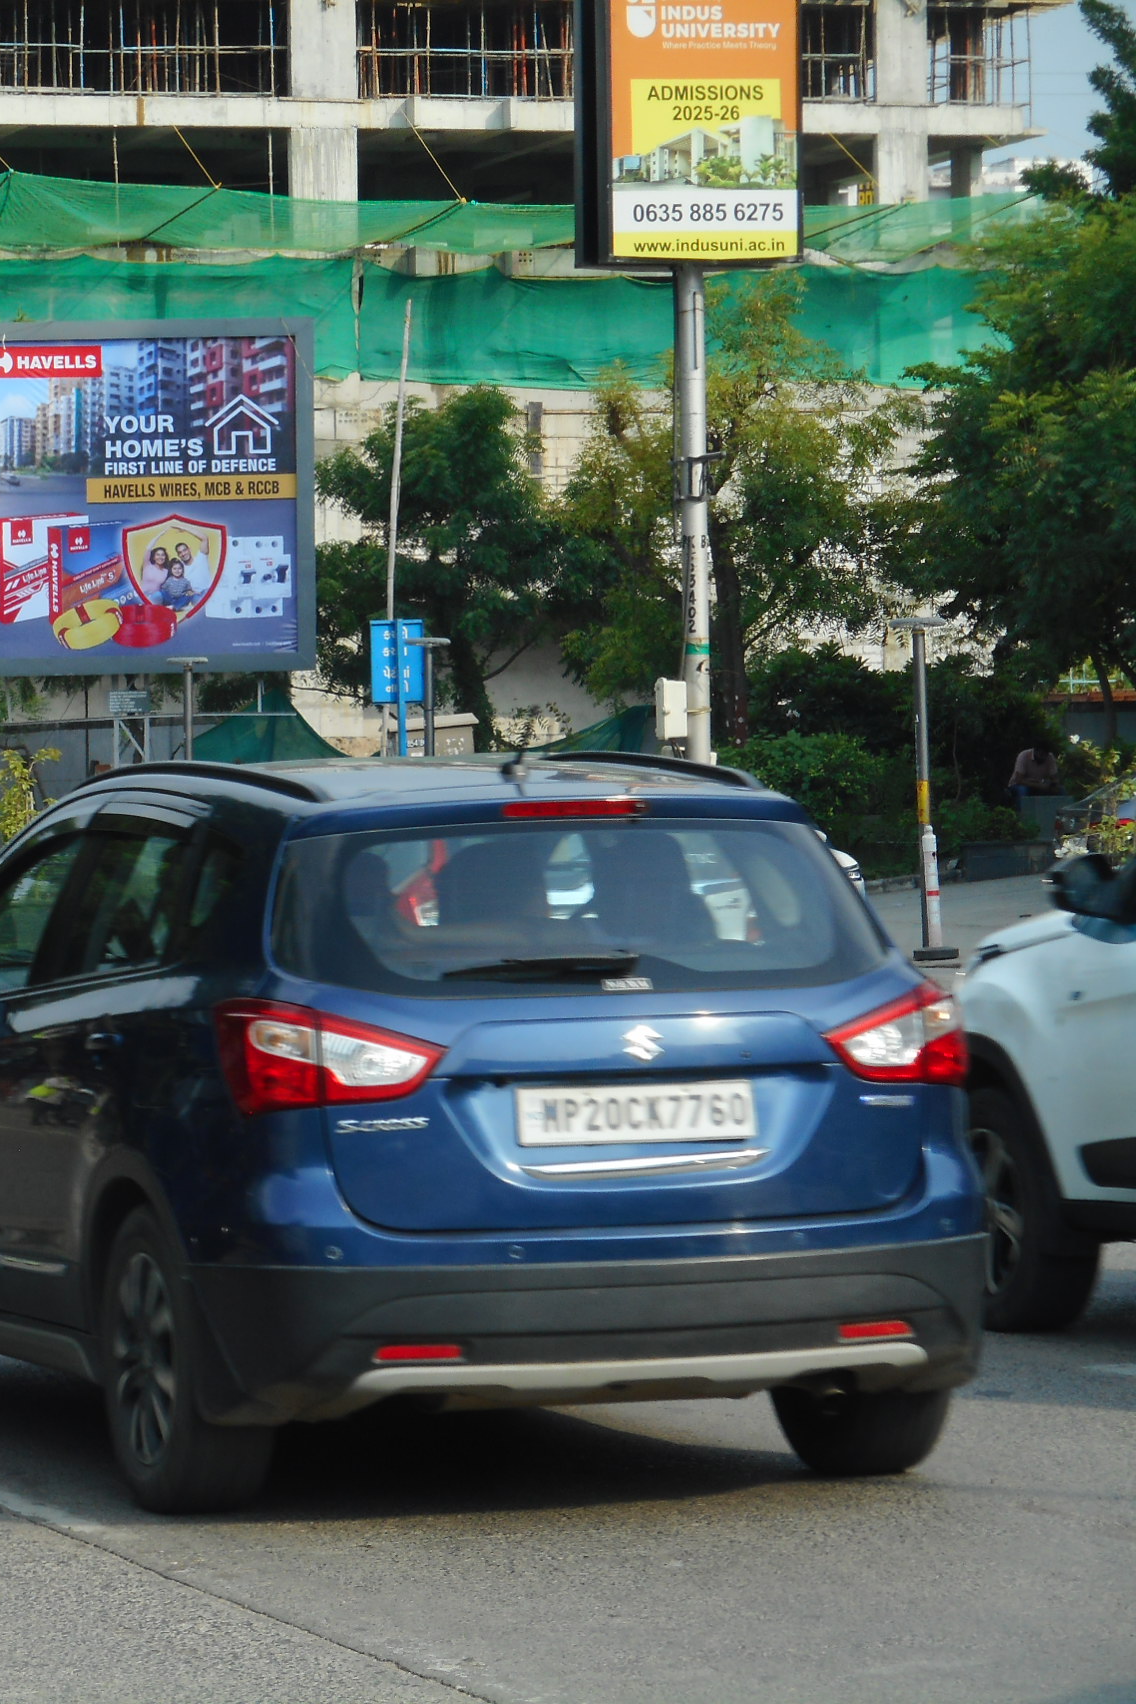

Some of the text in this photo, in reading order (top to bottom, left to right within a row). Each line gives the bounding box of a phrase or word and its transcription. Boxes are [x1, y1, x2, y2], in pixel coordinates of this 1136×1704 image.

[661, 5, 723, 21] INDUS
[661, 23, 780, 38] UNIVERSITY
[662, 41, 688, 49] Where
[723, 41, 748, 49] Meets
[749, 41, 776, 51] Theory
[647, 85, 764, 101] ADMISSIONS
[672, 105, 740, 121] 2025-26
[633, 203, 784, 222] 0635 885 6275
[634, 238, 785, 252] www.indusuni.ac.in
[17, 354, 97, 370] HAVELLS
[104, 415, 174, 435] YOUR
[104, 458, 277, 476] FIRST LINE OF DEFENCE
[103, 480, 280, 499] HAVELLS WIRES, MCB & RCCB
